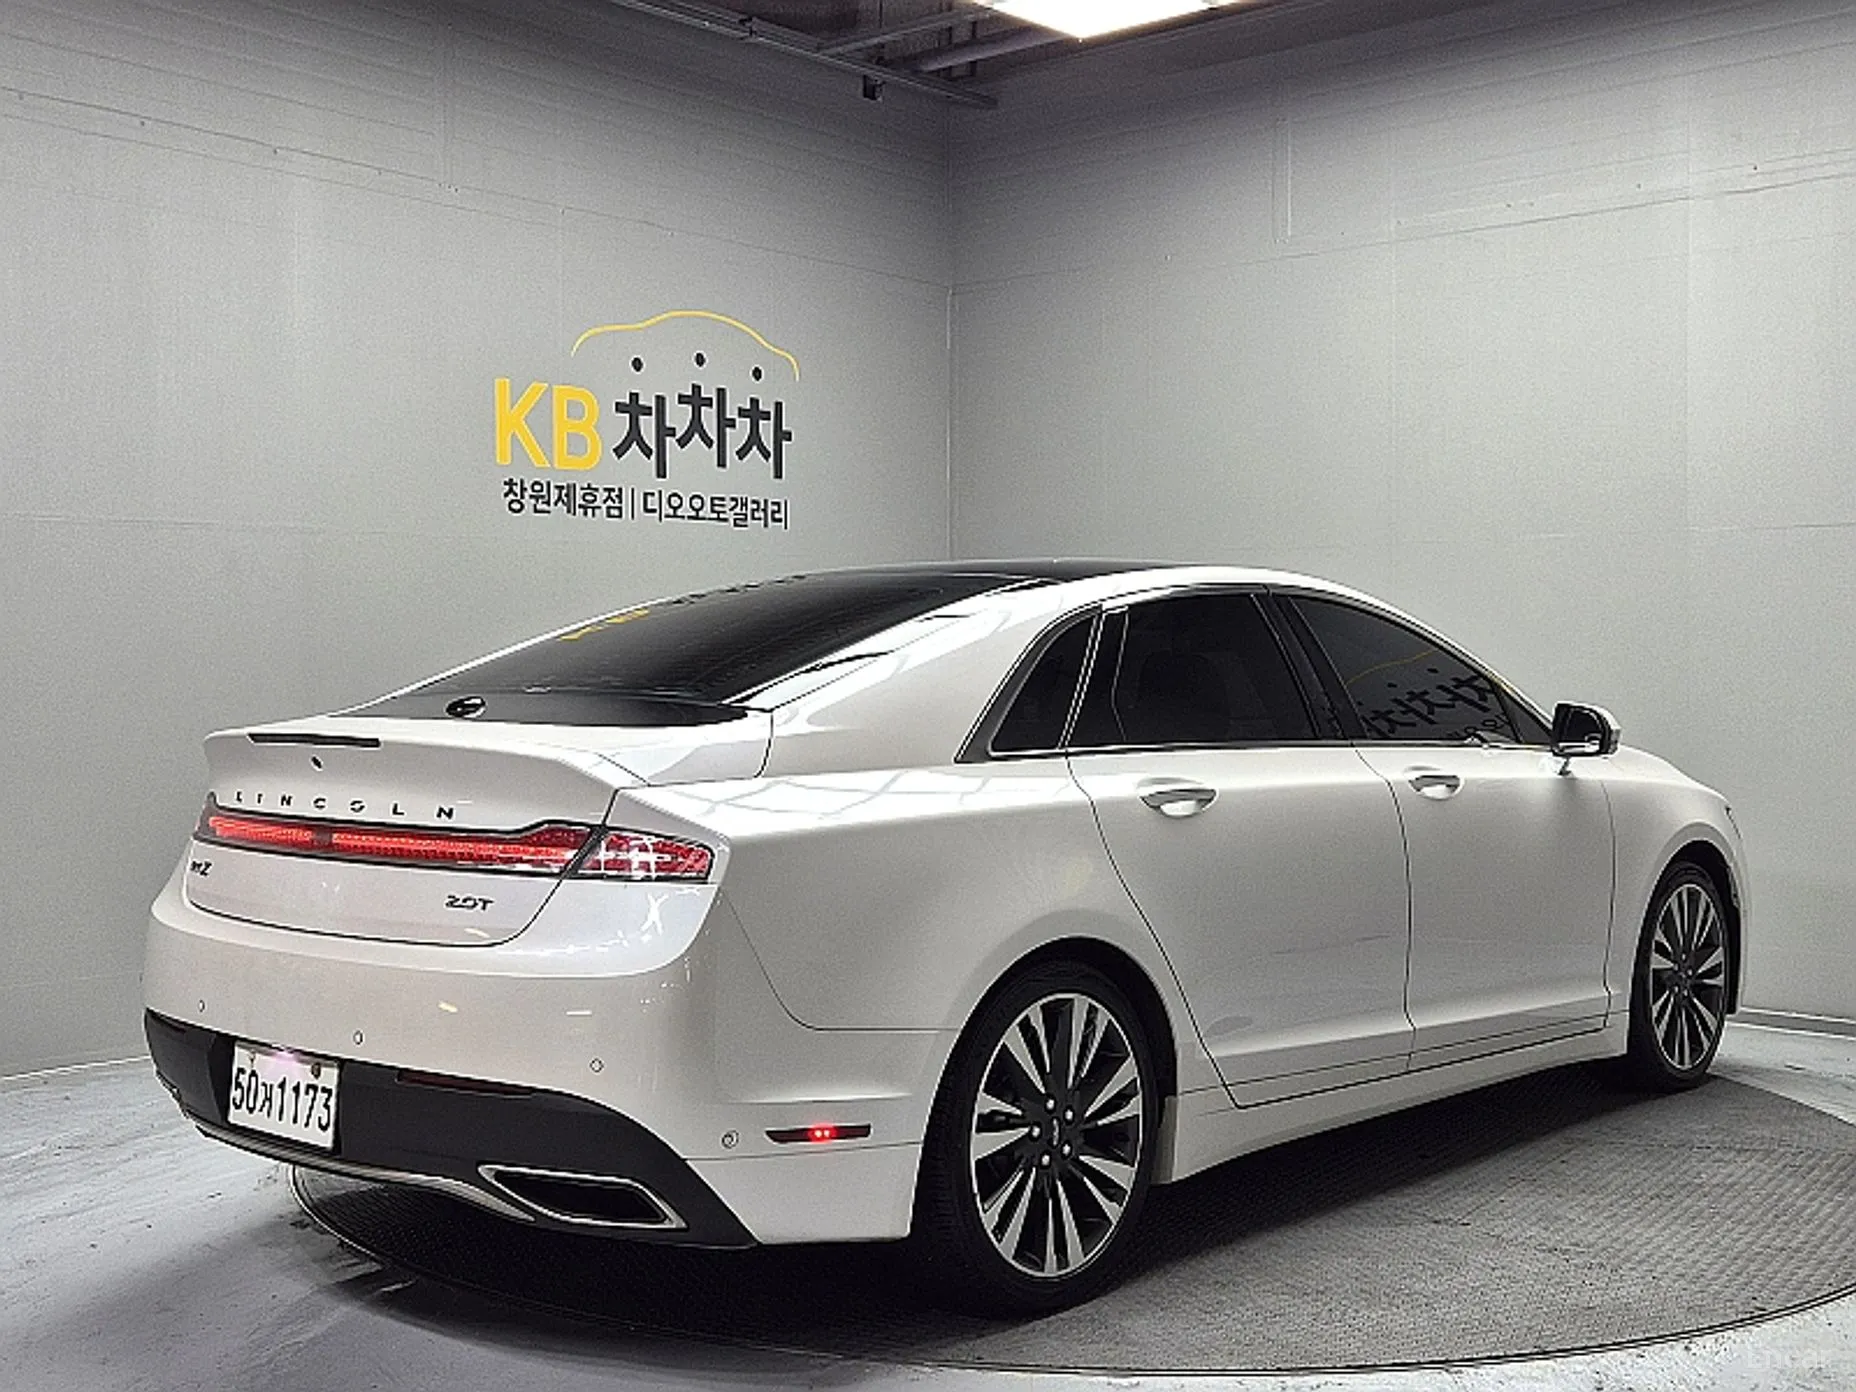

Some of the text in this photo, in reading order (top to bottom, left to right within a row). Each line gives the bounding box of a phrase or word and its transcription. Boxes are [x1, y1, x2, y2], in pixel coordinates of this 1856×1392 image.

[494, 376, 793, 480] KB 차차차
[502, 478, 789, 531] 창원제휴점 디오오토갤러리
[235, 791, 455, 820] LINCOLN
